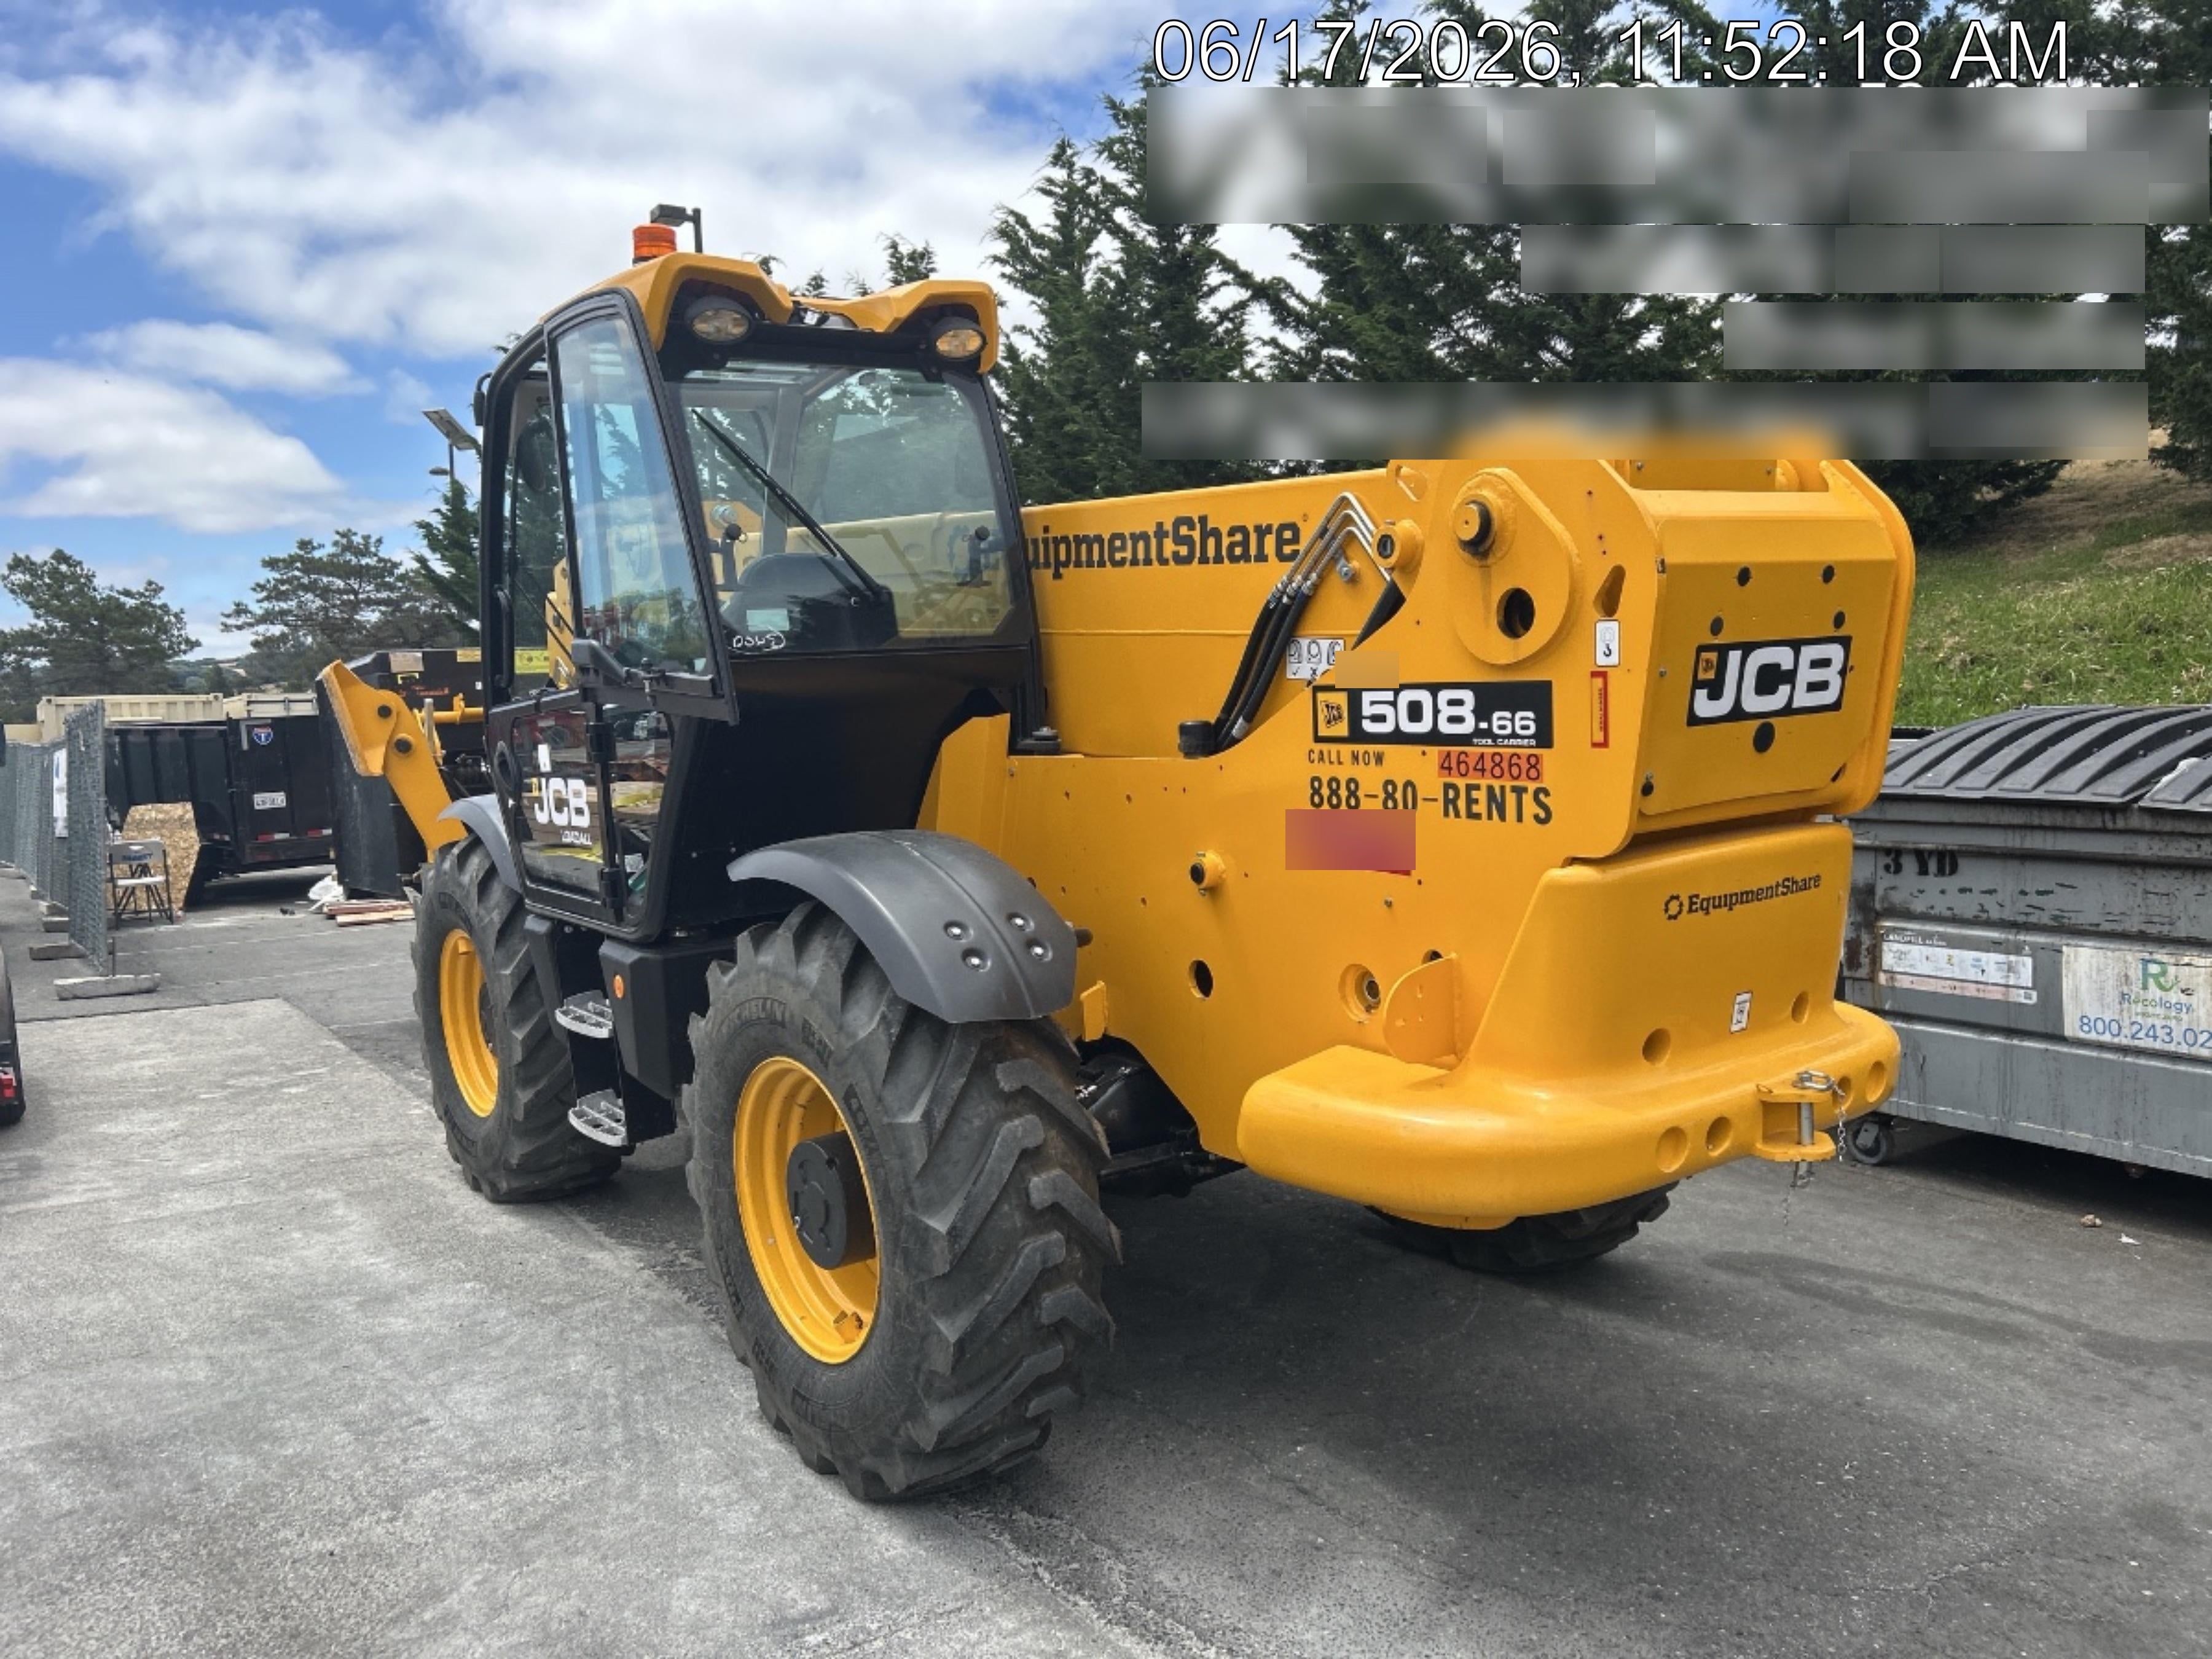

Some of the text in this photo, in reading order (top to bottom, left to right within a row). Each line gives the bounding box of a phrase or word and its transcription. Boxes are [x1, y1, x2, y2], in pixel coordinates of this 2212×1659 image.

[1022, 514, 1301, 580] uipmentShare
[1693, 642, 1844, 718] JCB
[1308, 748, 1385, 767] CALL NOW
[1440, 751, 1540, 781] 464868
[534, 777, 590, 828] JCB
[1883, 849, 1959, 877] 3 YD
[1687, 873, 1822, 916] EquipmentShare
[2120, 991, 2193, 1014] Recology
